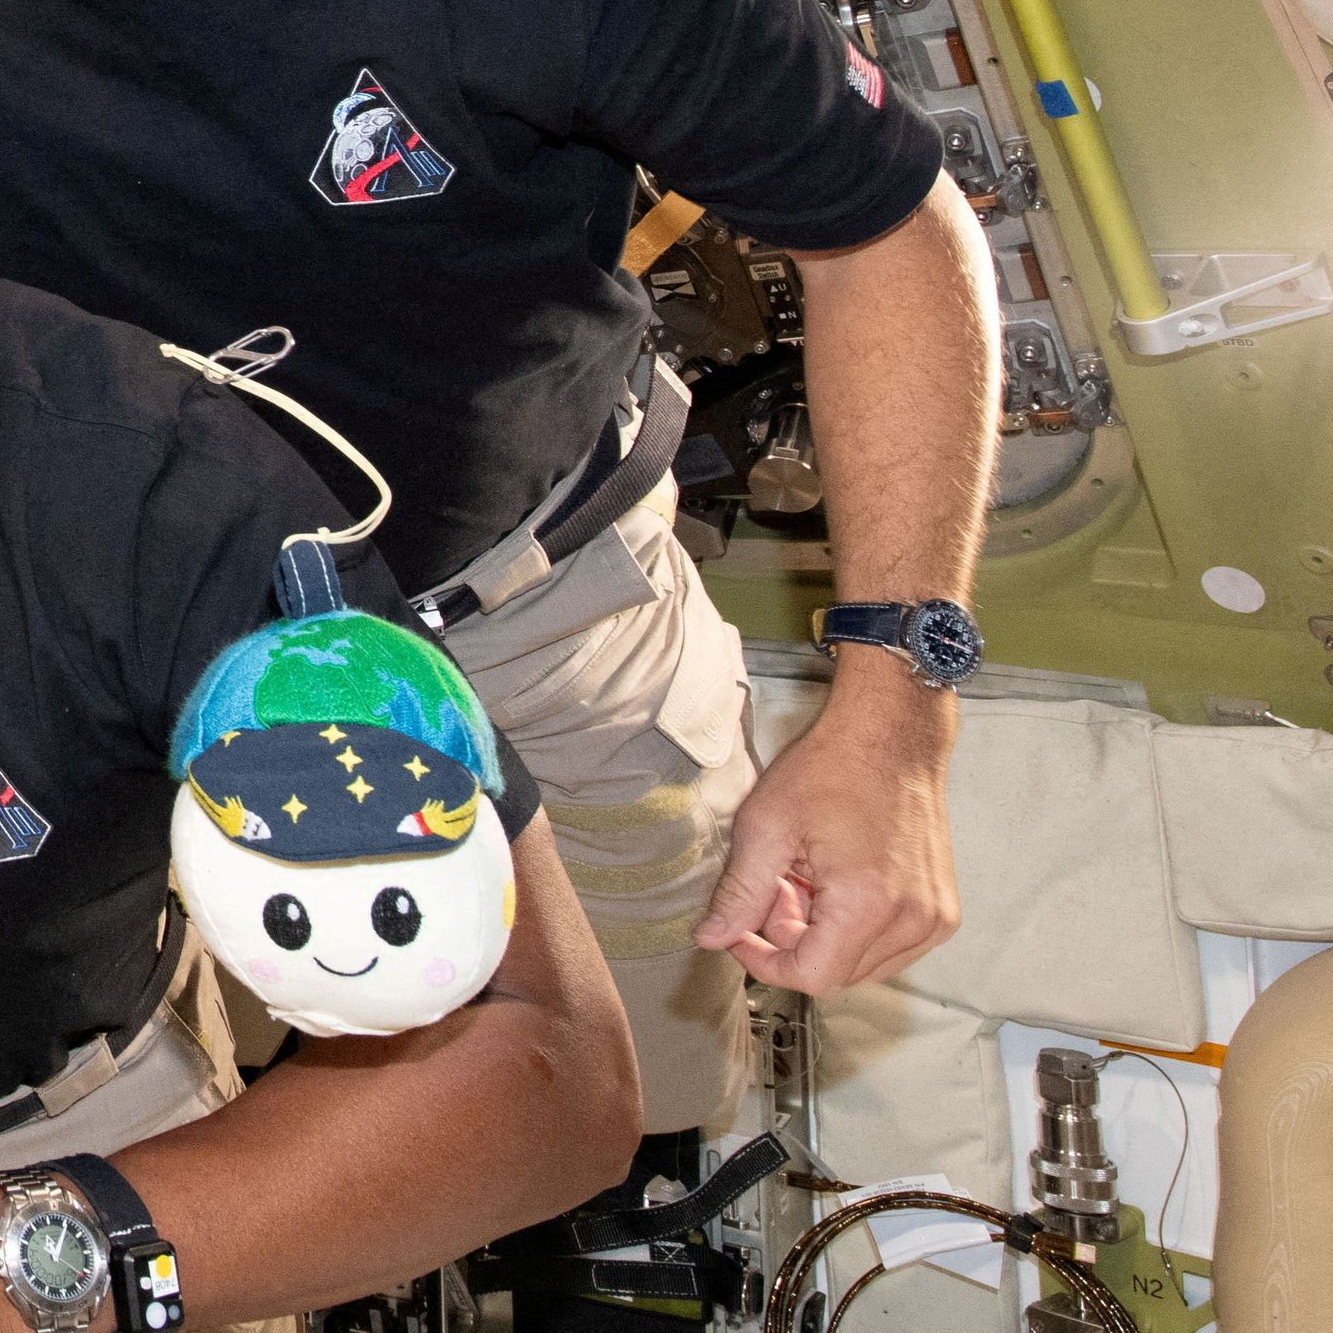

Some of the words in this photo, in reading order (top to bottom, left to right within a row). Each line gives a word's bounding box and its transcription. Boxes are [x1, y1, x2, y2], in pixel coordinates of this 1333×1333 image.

[758, 271, 779, 279] Switch
[788, 311, 797, 319] N
[1221, 338, 1254, 347] STBD
[1132, 1274, 1164, 1300] N2
